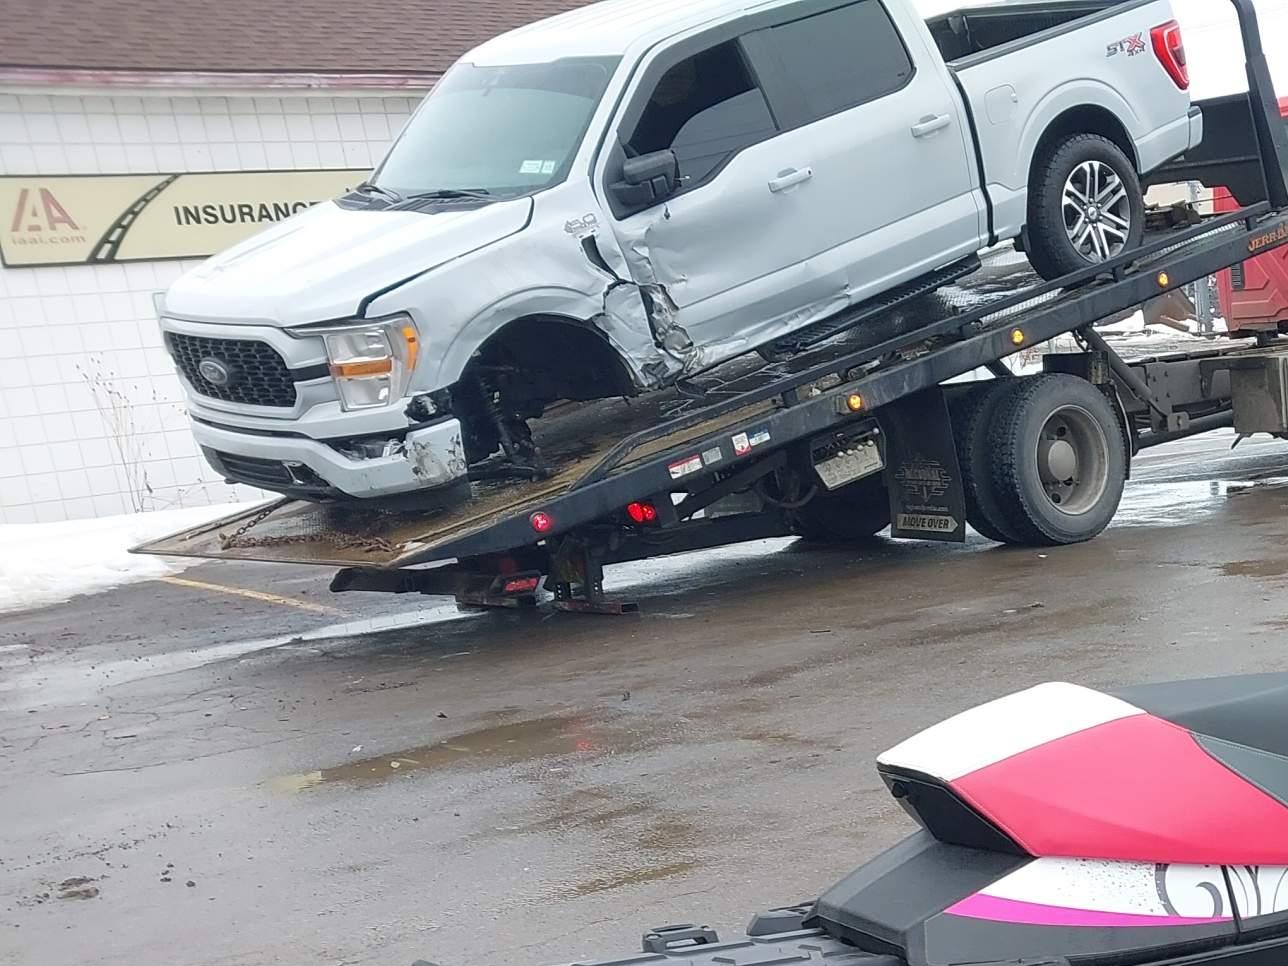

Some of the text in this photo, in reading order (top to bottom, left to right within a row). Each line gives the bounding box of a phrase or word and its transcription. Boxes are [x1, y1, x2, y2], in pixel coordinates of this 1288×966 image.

[174, 201, 321, 225] INSURANC
[11, 235, 87, 246] iaai.com
[902, 515, 949, 529] MOVE OVER
